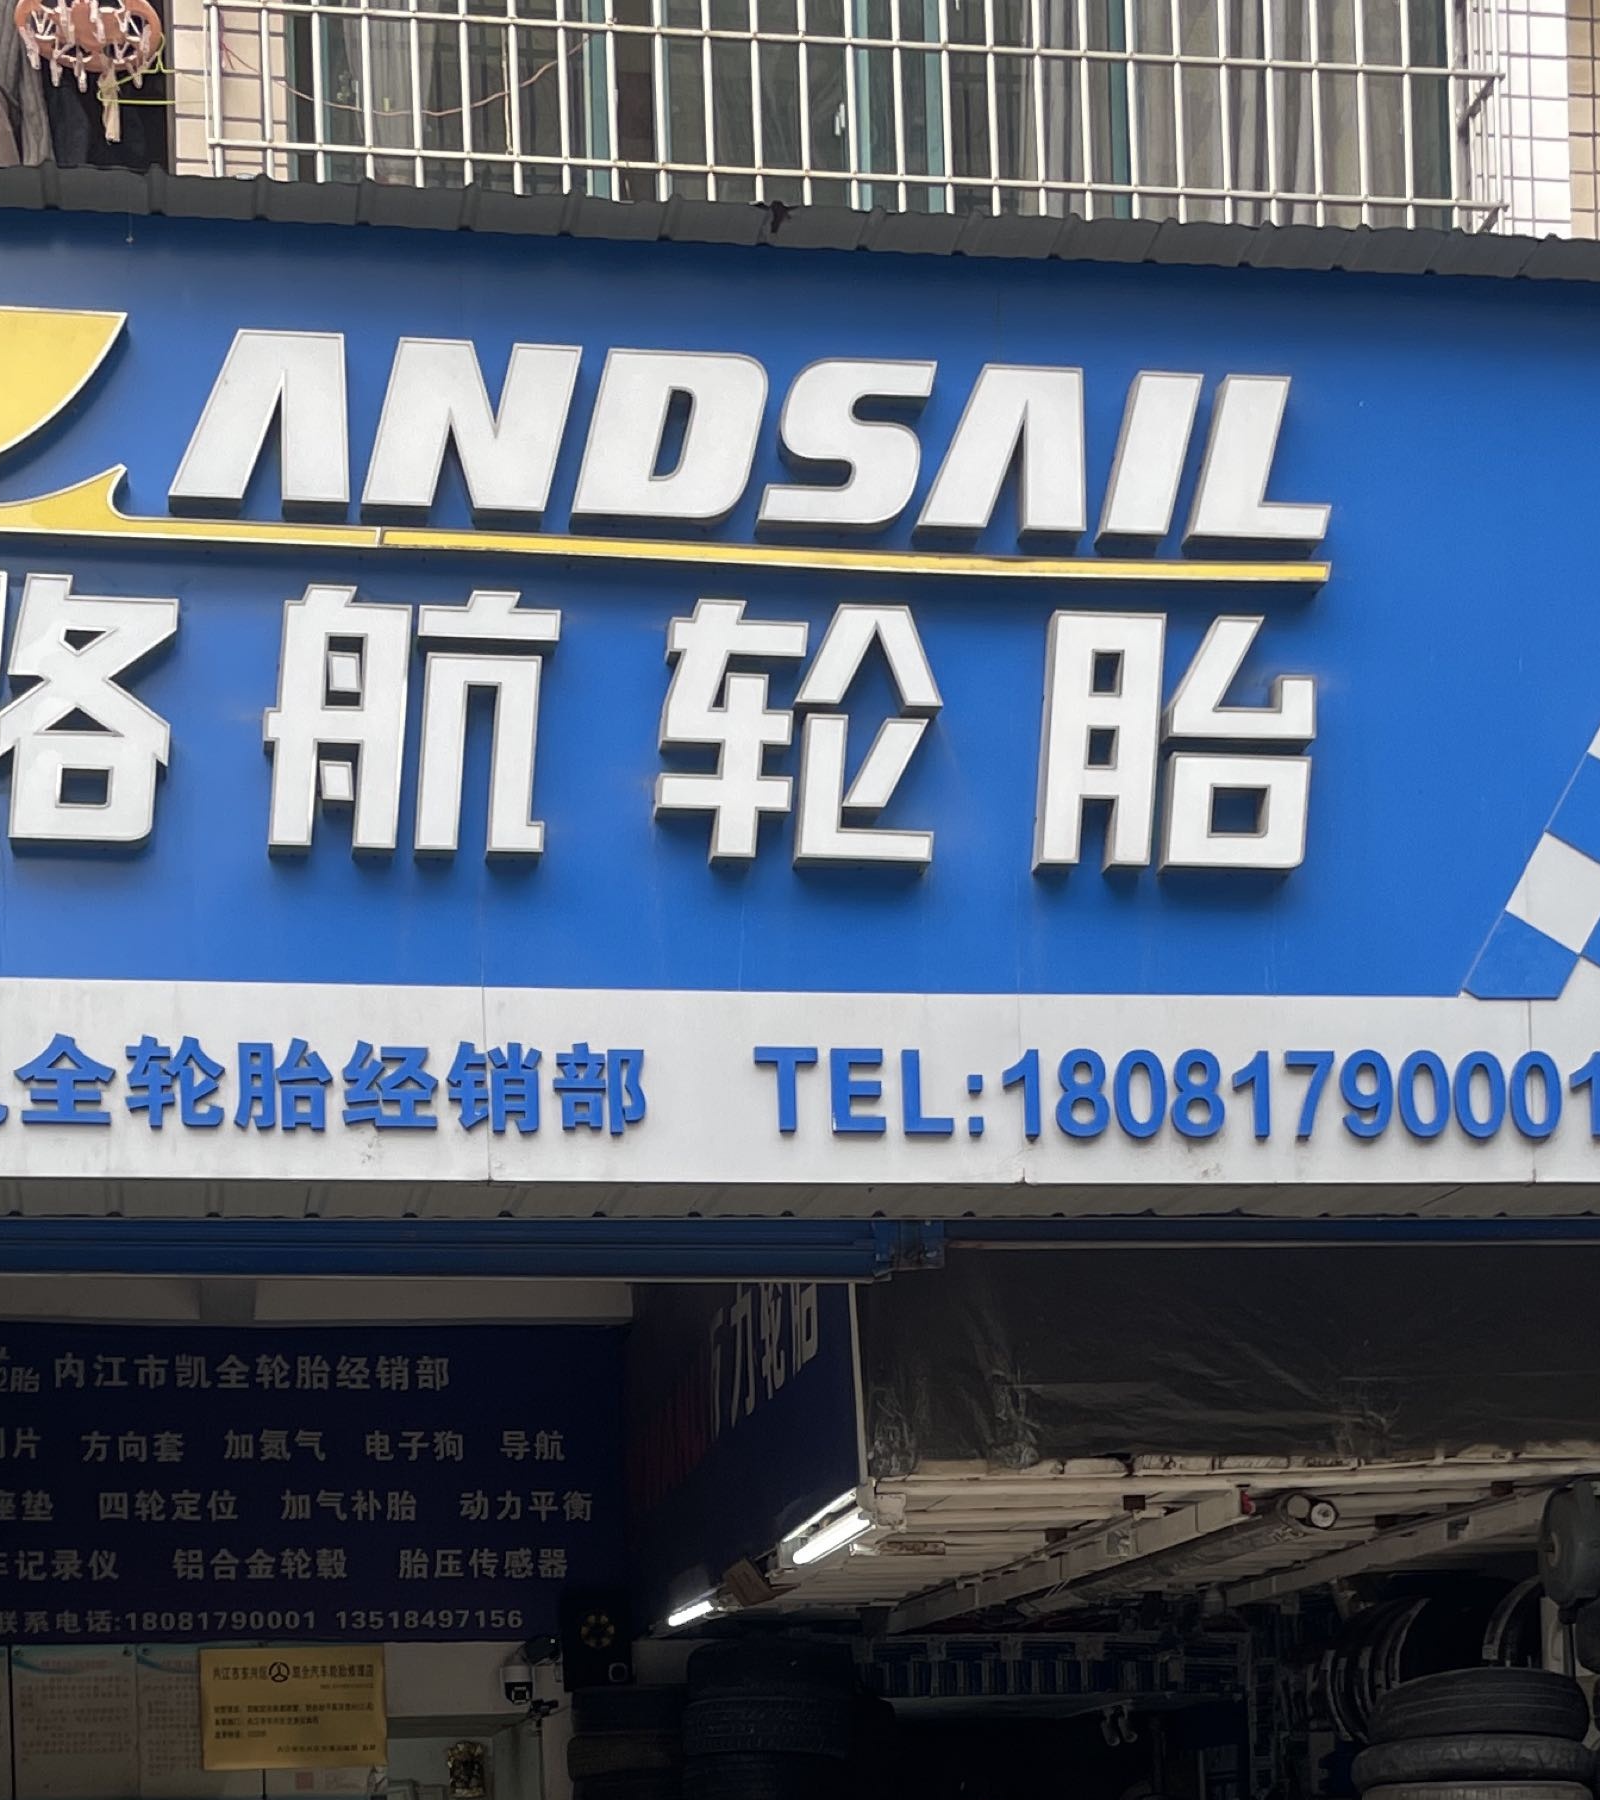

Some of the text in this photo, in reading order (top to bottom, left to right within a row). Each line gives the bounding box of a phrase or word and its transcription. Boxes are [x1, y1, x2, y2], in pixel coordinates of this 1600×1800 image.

[53, 1352, 450, 1392] 内江市凯全轮胎经销部
[80, 1430, 185, 1463] 方向套
[224, 1429, 326, 1462] 加氮气
[365, 1430, 464, 1462] 电子狗
[500, 1429, 566, 1461] 导航
[98, 1489, 239, 1521] 四轮定位
[280, 1489, 417, 1521] 加气补胎
[459, 1489, 594, 1522] 动力平衡
[398, 1549, 569, 1580] 胎压传感器
[336, 1610, 524, 1631] 13518497156
